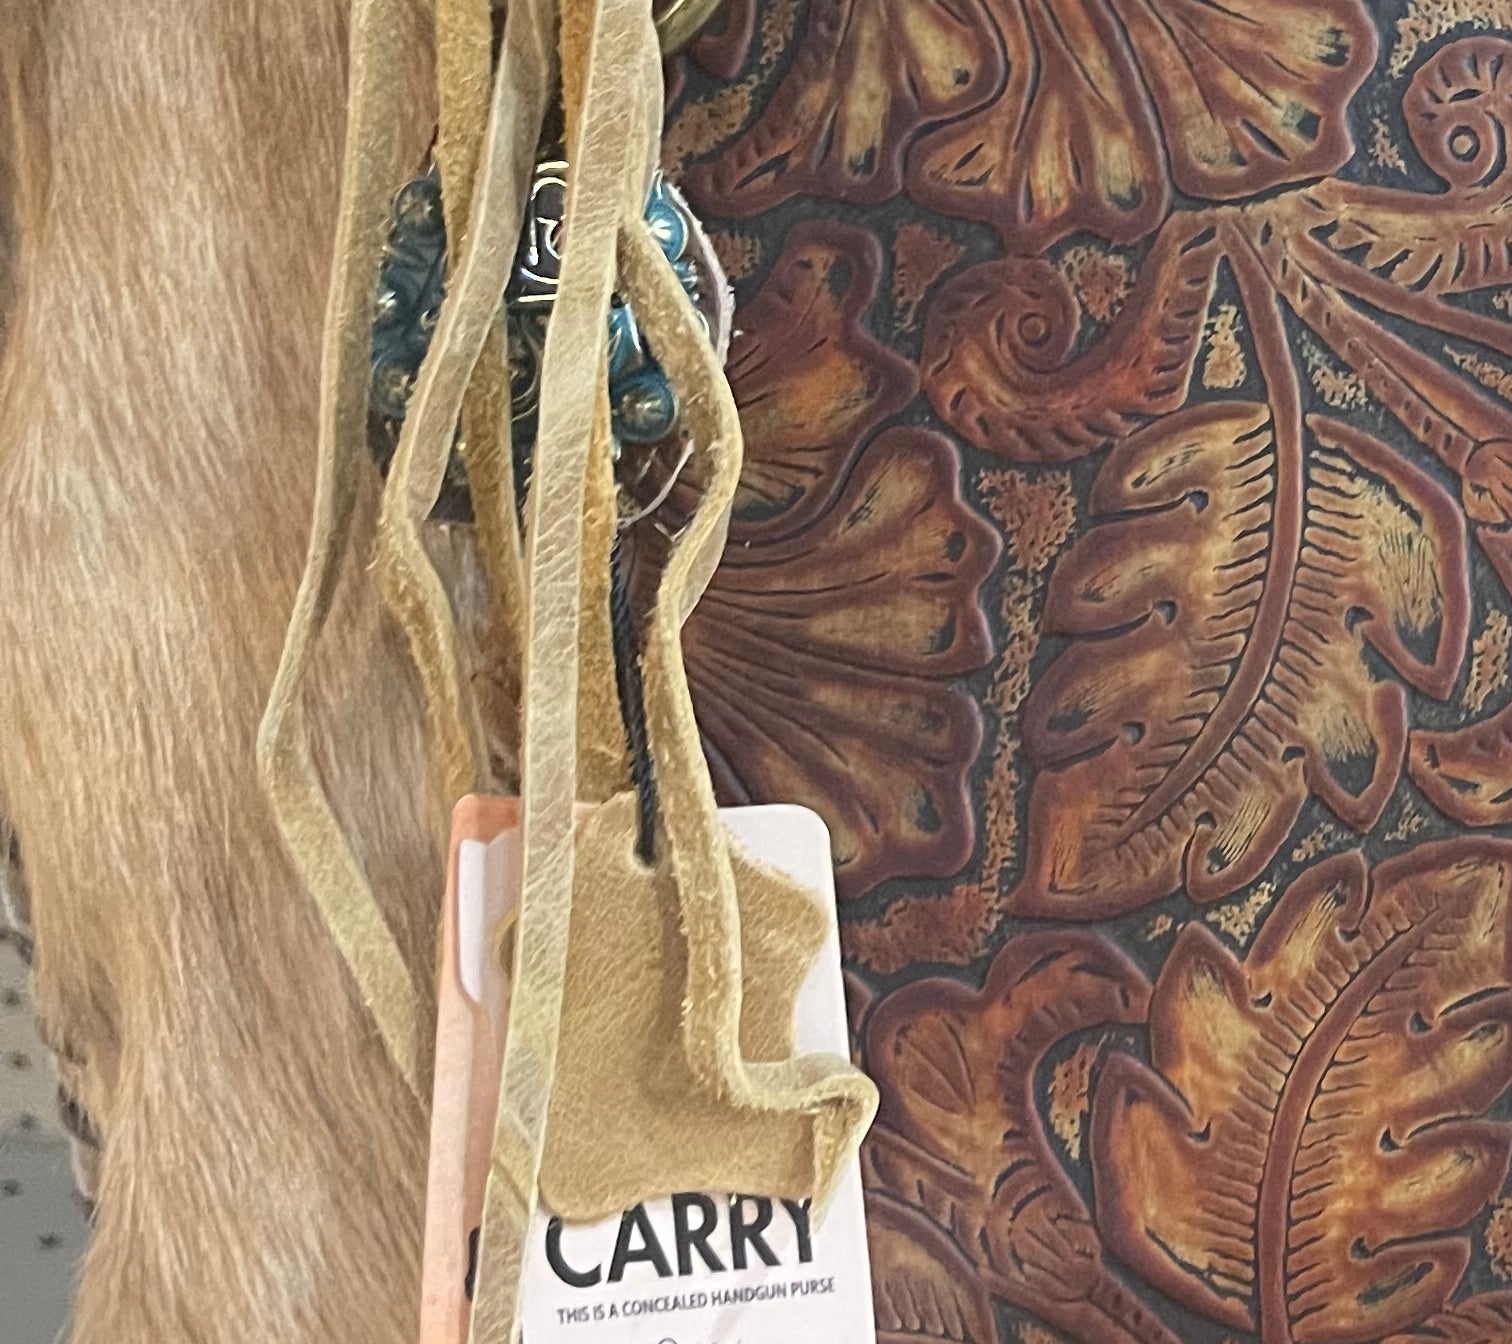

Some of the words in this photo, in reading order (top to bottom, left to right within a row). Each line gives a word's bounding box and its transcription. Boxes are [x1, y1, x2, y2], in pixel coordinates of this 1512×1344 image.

[545, 1192, 814, 1288] CARRY
[557, 1305, 590, 1325] THIS
[593, 1303, 605, 1321] IS
[609, 1302, 619, 1318] A
[622, 1292, 708, 1317] CONCEALED
[711, 1282, 787, 1306] HANDGUN
[790, 1276, 835, 1297] PURSE
